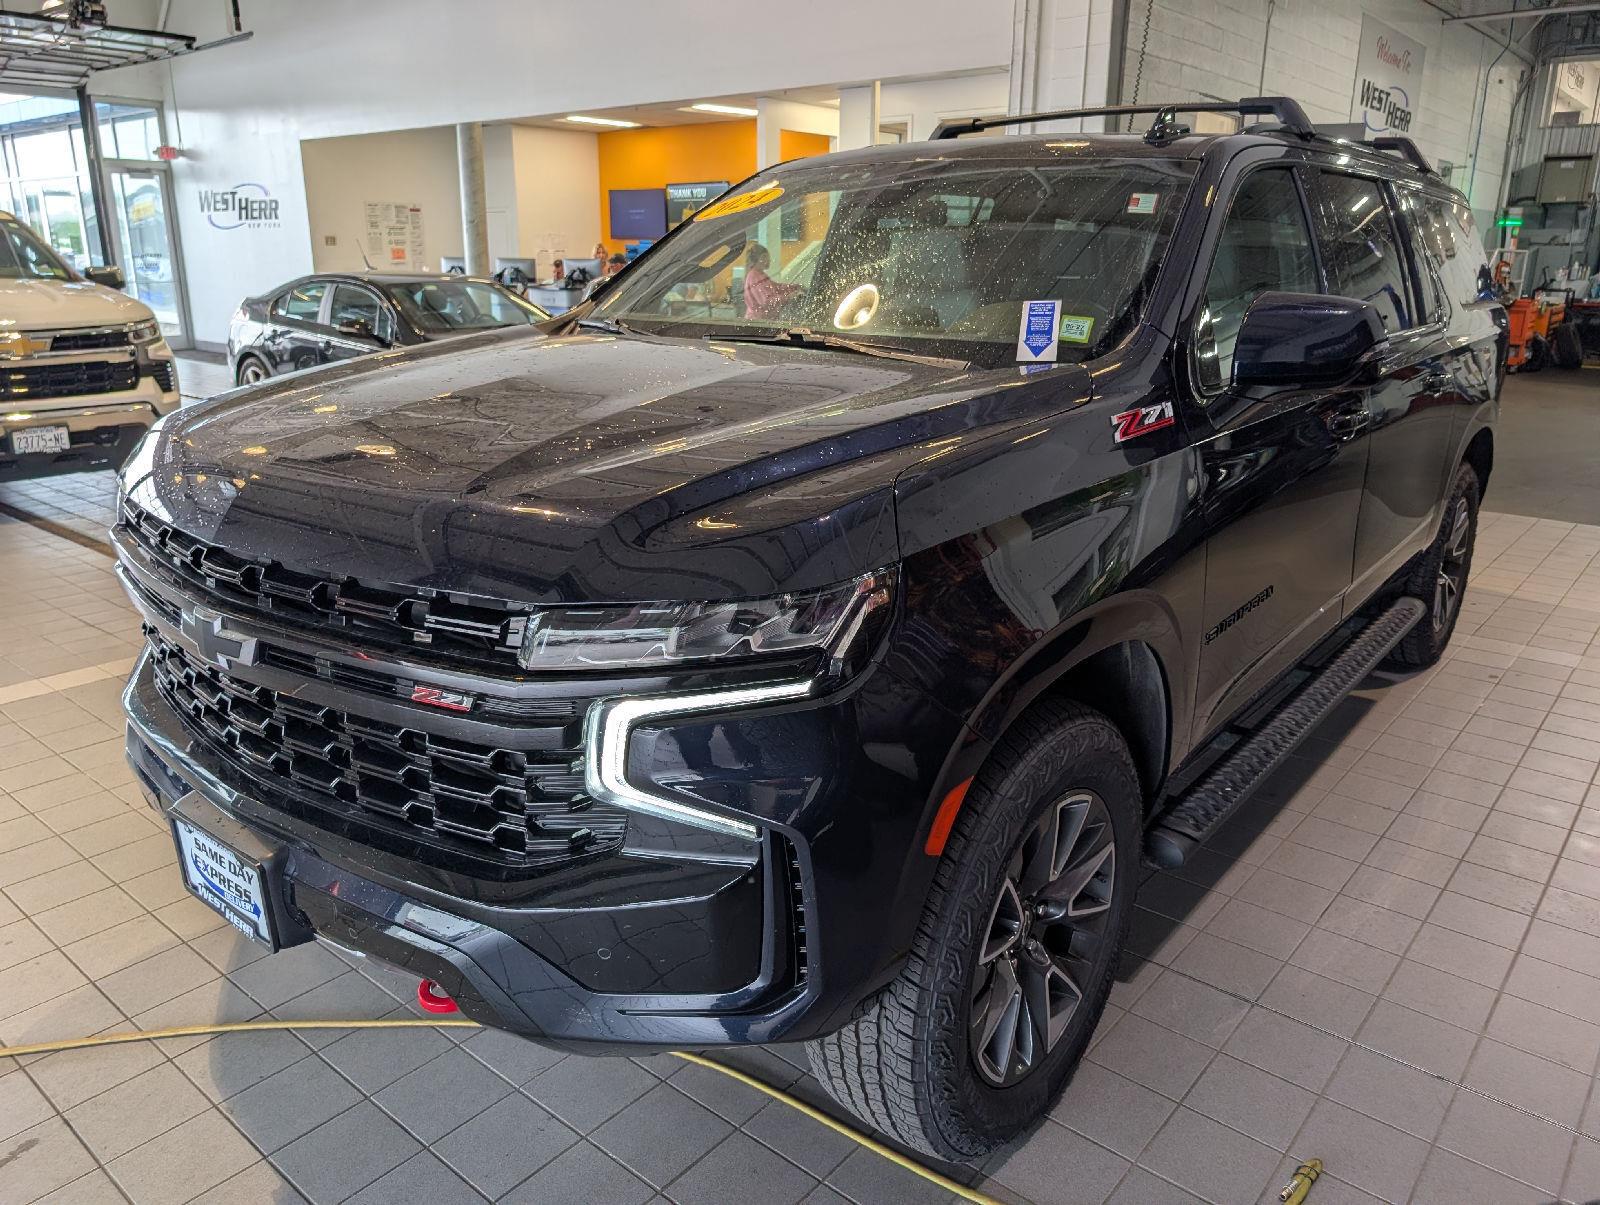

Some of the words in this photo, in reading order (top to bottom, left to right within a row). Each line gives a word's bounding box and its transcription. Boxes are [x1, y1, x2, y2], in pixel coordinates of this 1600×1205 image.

[1360, 79, 1391, 114] WEST
[1385, 101, 1412, 133] HERR
[199, 190, 237, 213] WEST
[238, 197, 279, 221] HERR
[670, 188, 692, 198] THANK
[693, 187, 707, 198] YOU
[1110, 401, 1175, 444] Z71
[411, 685, 474, 712] Z71
[194, 837, 226, 870] SAME
[228, 859, 254, 886] DAY
[194, 853, 252, 905] EXPRESS
[199, 887, 227, 911] WEST
[225, 907, 254, 938] HERR
[224, 890, 254, 913] DELIVERY
